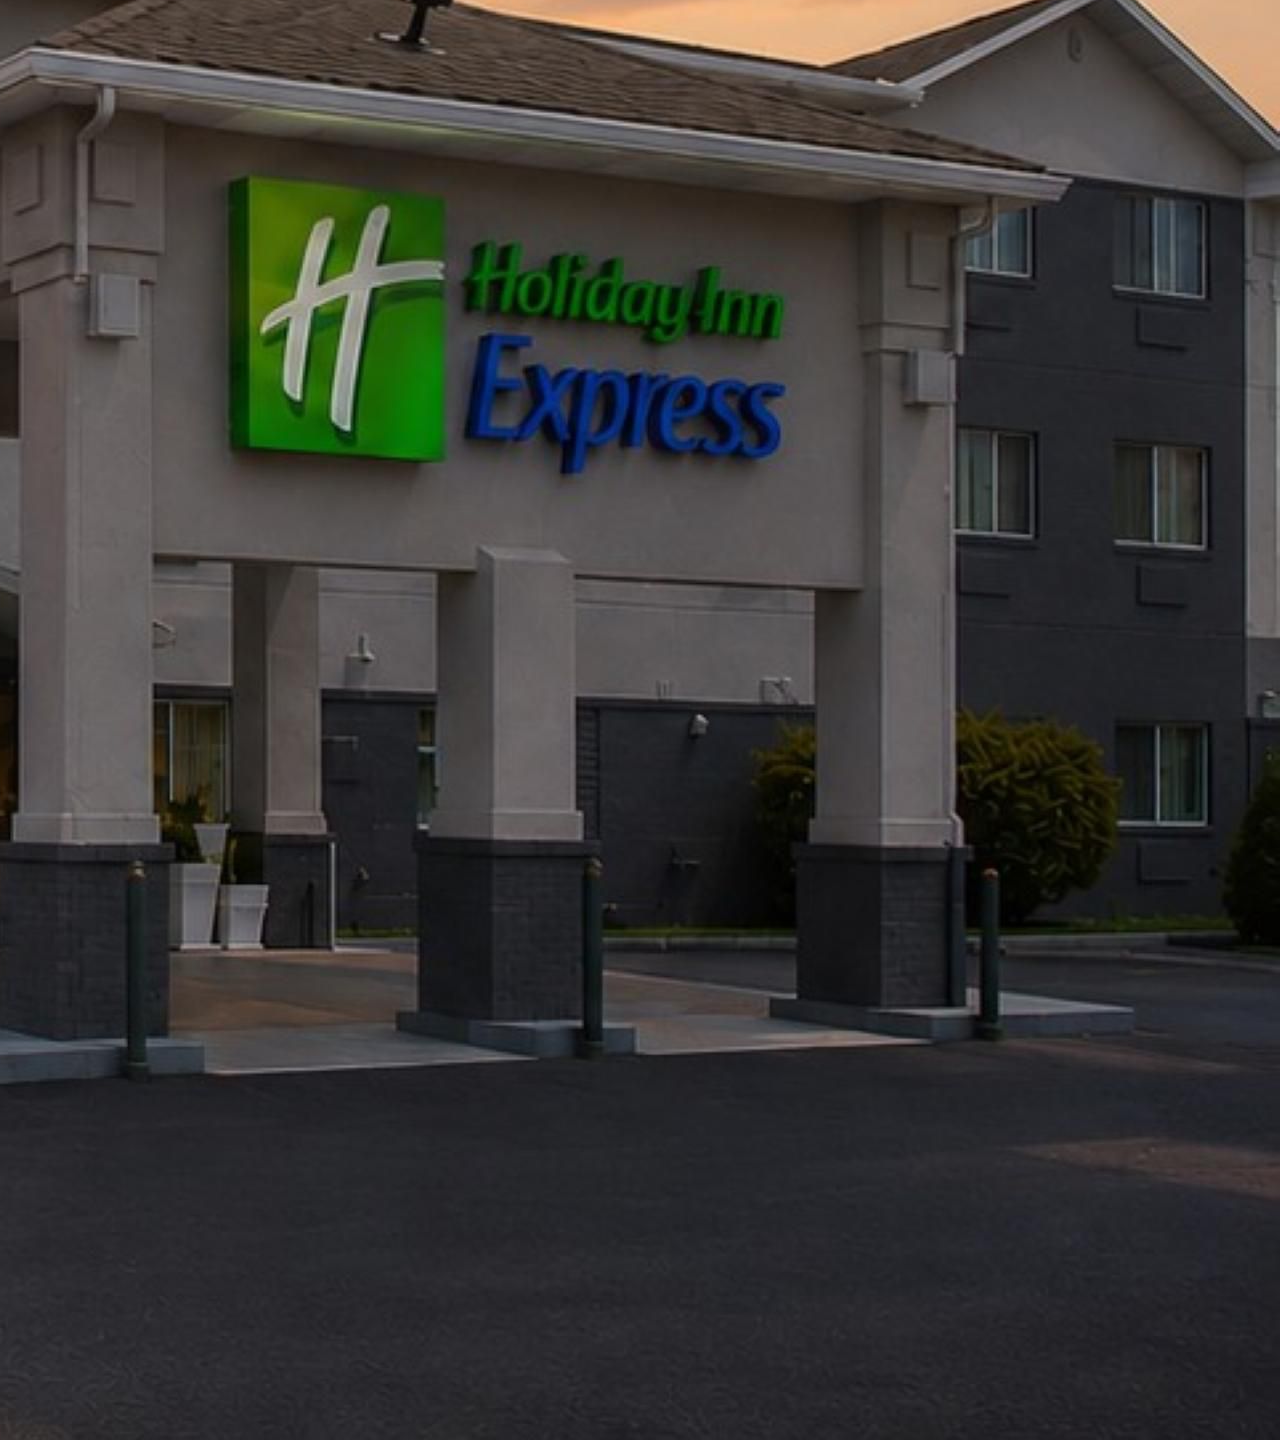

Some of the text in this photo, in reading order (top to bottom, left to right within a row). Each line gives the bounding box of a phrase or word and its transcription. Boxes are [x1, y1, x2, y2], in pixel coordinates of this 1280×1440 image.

[463, 240, 785, 343] Holiday Inn
[465, 332, 786, 474] Express
